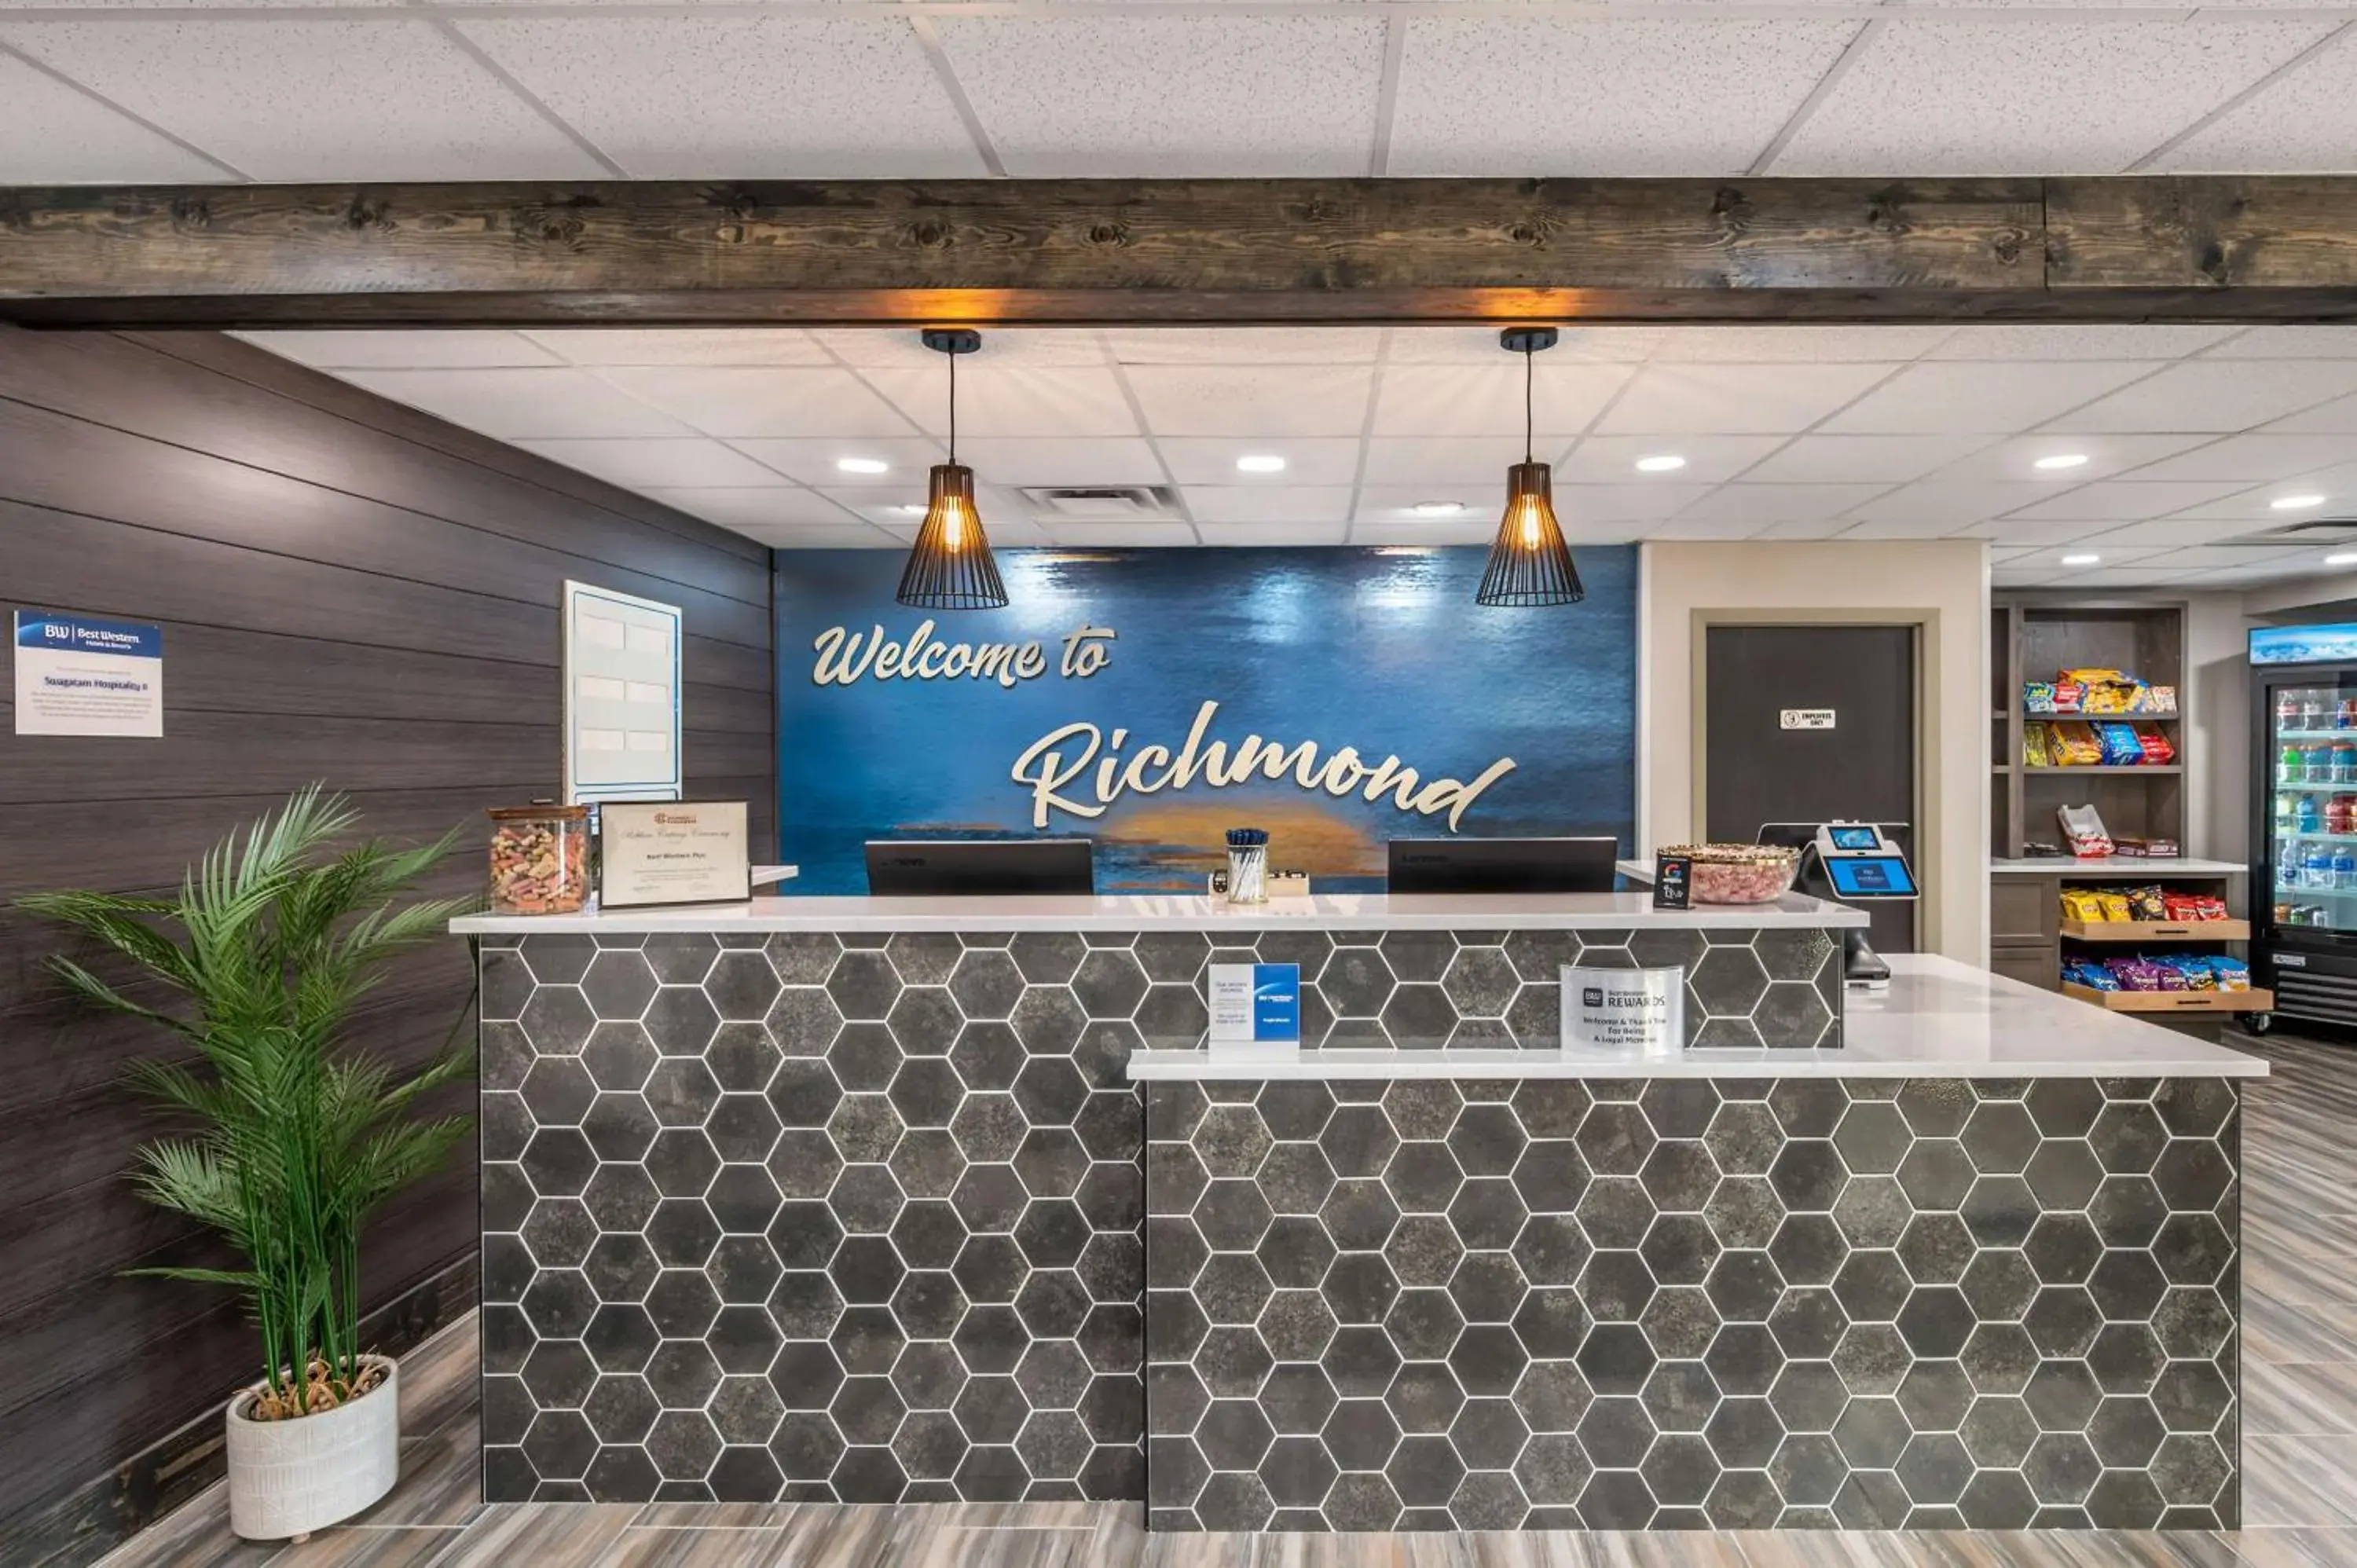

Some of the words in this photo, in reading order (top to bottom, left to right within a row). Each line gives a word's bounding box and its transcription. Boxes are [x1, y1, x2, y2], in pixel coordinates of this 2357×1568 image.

[45, 625, 69, 639] BW
[78, 628, 100, 639] Best
[101, 630, 140, 643] Western
[812, 620, 1046, 687] Welcome
[1060, 624, 1117, 678] to
[93, 680, 141, 691] Hospitality
[1011, 700, 1517, 833] Richmond
[1608, 995, 1665, 1007] REWARDS
